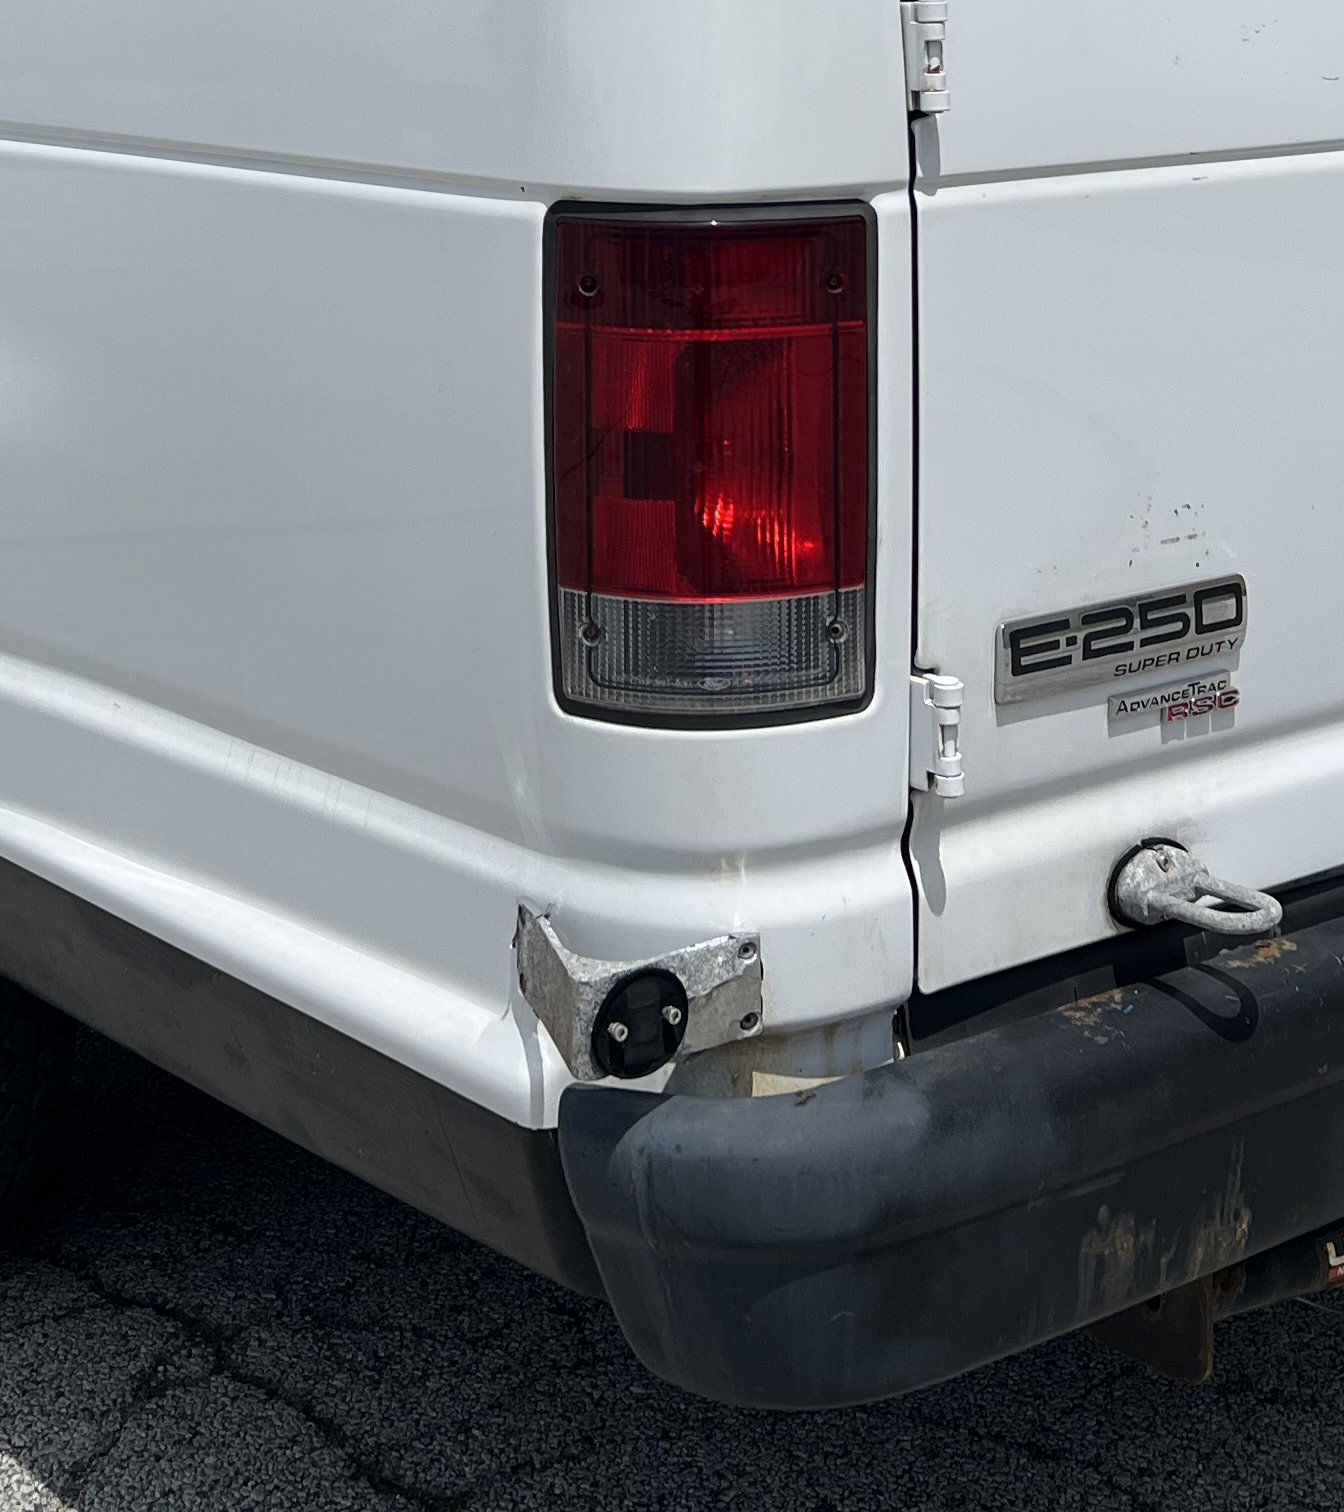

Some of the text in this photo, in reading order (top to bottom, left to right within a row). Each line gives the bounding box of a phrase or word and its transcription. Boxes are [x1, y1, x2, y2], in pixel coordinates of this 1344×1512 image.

[1009, 582, 1243, 677] E-250
[1114, 637, 1239, 677] SUPER DUTY
[1167, 687, 1240, 722] RSC
